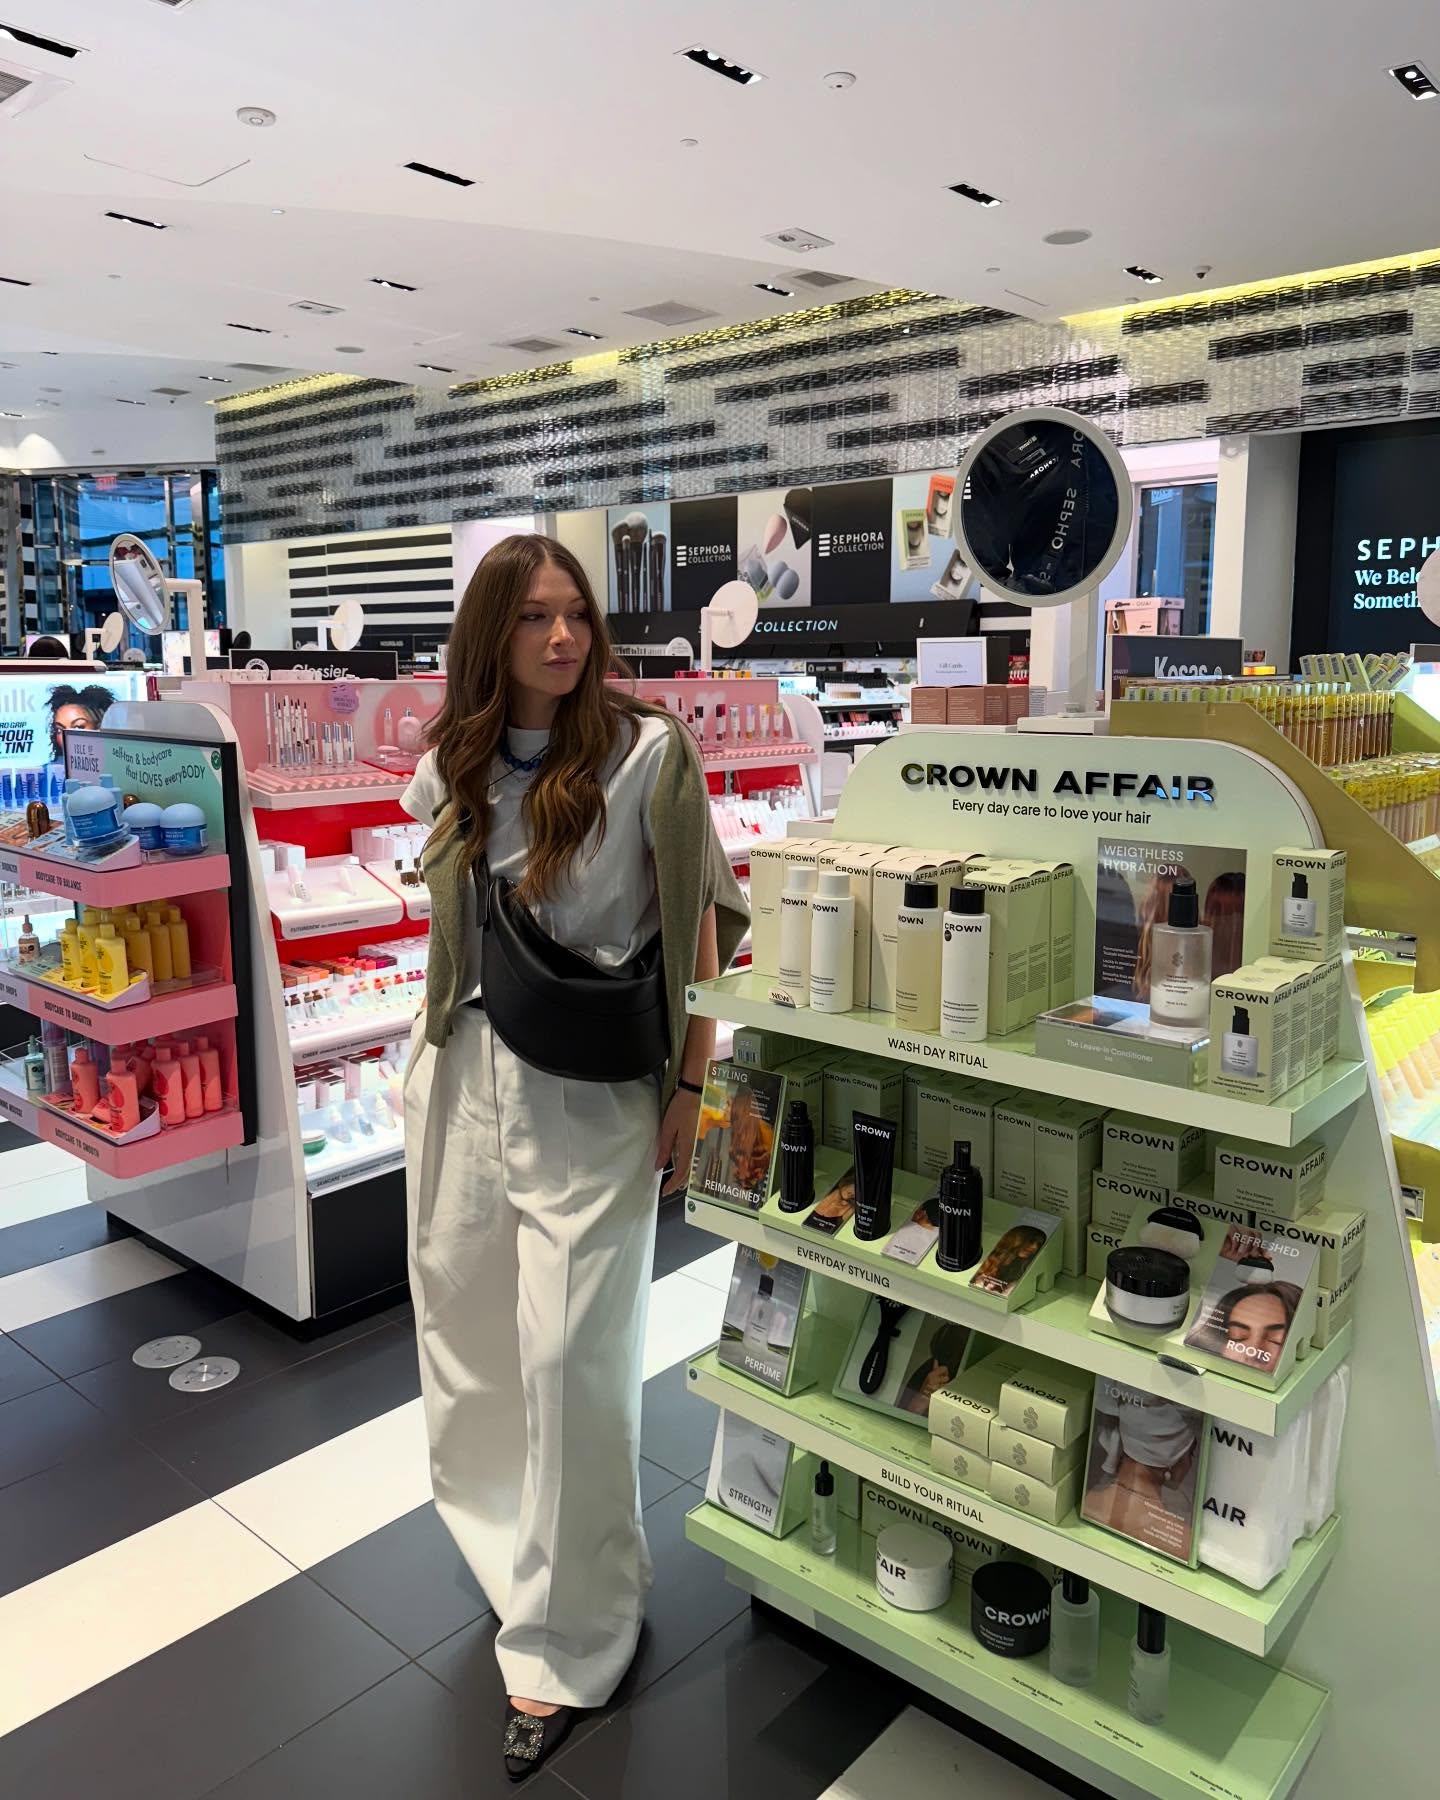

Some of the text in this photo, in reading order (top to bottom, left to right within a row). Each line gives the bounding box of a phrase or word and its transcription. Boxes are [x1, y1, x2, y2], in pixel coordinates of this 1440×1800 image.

[832, 531, 884, 544] SEPHORA
[688, 543, 731, 556] SEPHORA
[832, 541, 885, 555] COLLECTION
[688, 553, 732, 565] COLLECTION
[1355, 570, 1381, 586] We
[754, 619, 838, 633] COLLECTION
[5, 741, 34, 753] TINT
[74, 744, 87, 755] ISLE
[70, 756, 100, 773] PARADISE
[135, 753, 141, 764] &
[142, 748, 173, 766] bodycare
[126, 765, 206, 787] that LOVES everyBODY
[901, 763, 1215, 802] CROWN AFFAIR
[952, 799, 1152, 824] Every day care to love your hair
[750, 850, 781, 859] CROWN
[784, 854, 816, 863] CROWN
[835, 865, 869, 877] CROWN
[940, 866, 962, 877] AFFAIR
[1103, 858, 1178, 876] HYDRATION
[1275, 858, 1327, 870] CROWN
[35, 871, 82, 891] BODYCARE TO BALANCE
[875, 870, 938, 882] CROWN AFFAIR
[1053, 869, 1073, 880] AFFAIR
[1010, 882, 1031, 893] AFFAIR
[944, 922, 982, 933] CROWN
[771, 991, 789, 1002] NEW
[1215, 988, 1269, 1005] CROWN
[44, 1001, 64, 1018] BODYCARE
[888, 1037, 988, 1070] WASH DAY RITUAL
[1067, 1039, 1079, 1048] The
[1111, 1048, 1153, 1062] Conditioner
[711, 1066, 748, 1083] STYLING
[825, 1073, 851, 1084] CROWN
[851, 1078, 878, 1090] CROWN
[920, 1092, 951, 1105] CROWN
[953, 1104, 986, 1118] CROWN
[997, 1113, 1031, 1128] CROWN
[854, 1123, 890, 1140] CROWN
[1038, 1125, 1074, 1140] CROWN
[1107, 1127, 1174, 1151] CROWN
[1219, 1151, 1325, 1179] CROWN AFFAIR
[705, 1179, 760, 1204] REIMAGINED
[1096, 1177, 1162, 1203] CROWN
[1172, 1196, 1243, 1224] CROWN
[1259, 1219, 1365, 1250] CROWN AFFAIR
[1232, 1231, 1299, 1257] REFRESHED
[797, 1246, 890, 1288] EVERYDAY STYLING
[1226, 1339, 1272, 1362] ROOTS
[745, 1355, 781, 1382] PERFUME
[1012, 1380, 1066, 1405] CROWN
[1103, 1383, 1146, 1409] TOWEL
[940, 1390, 991, 1415] CROWN
[1211, 1426, 1253, 1456] WN
[728, 1487, 772, 1517] STRENGTH
[881, 1468, 984, 1523] BUILD YOUR RITUAL
[867, 1490, 923, 1524] CROWN
[932, 1520, 993, 1556] CROWN
[985, 1603, 1050, 1626] CROWN
